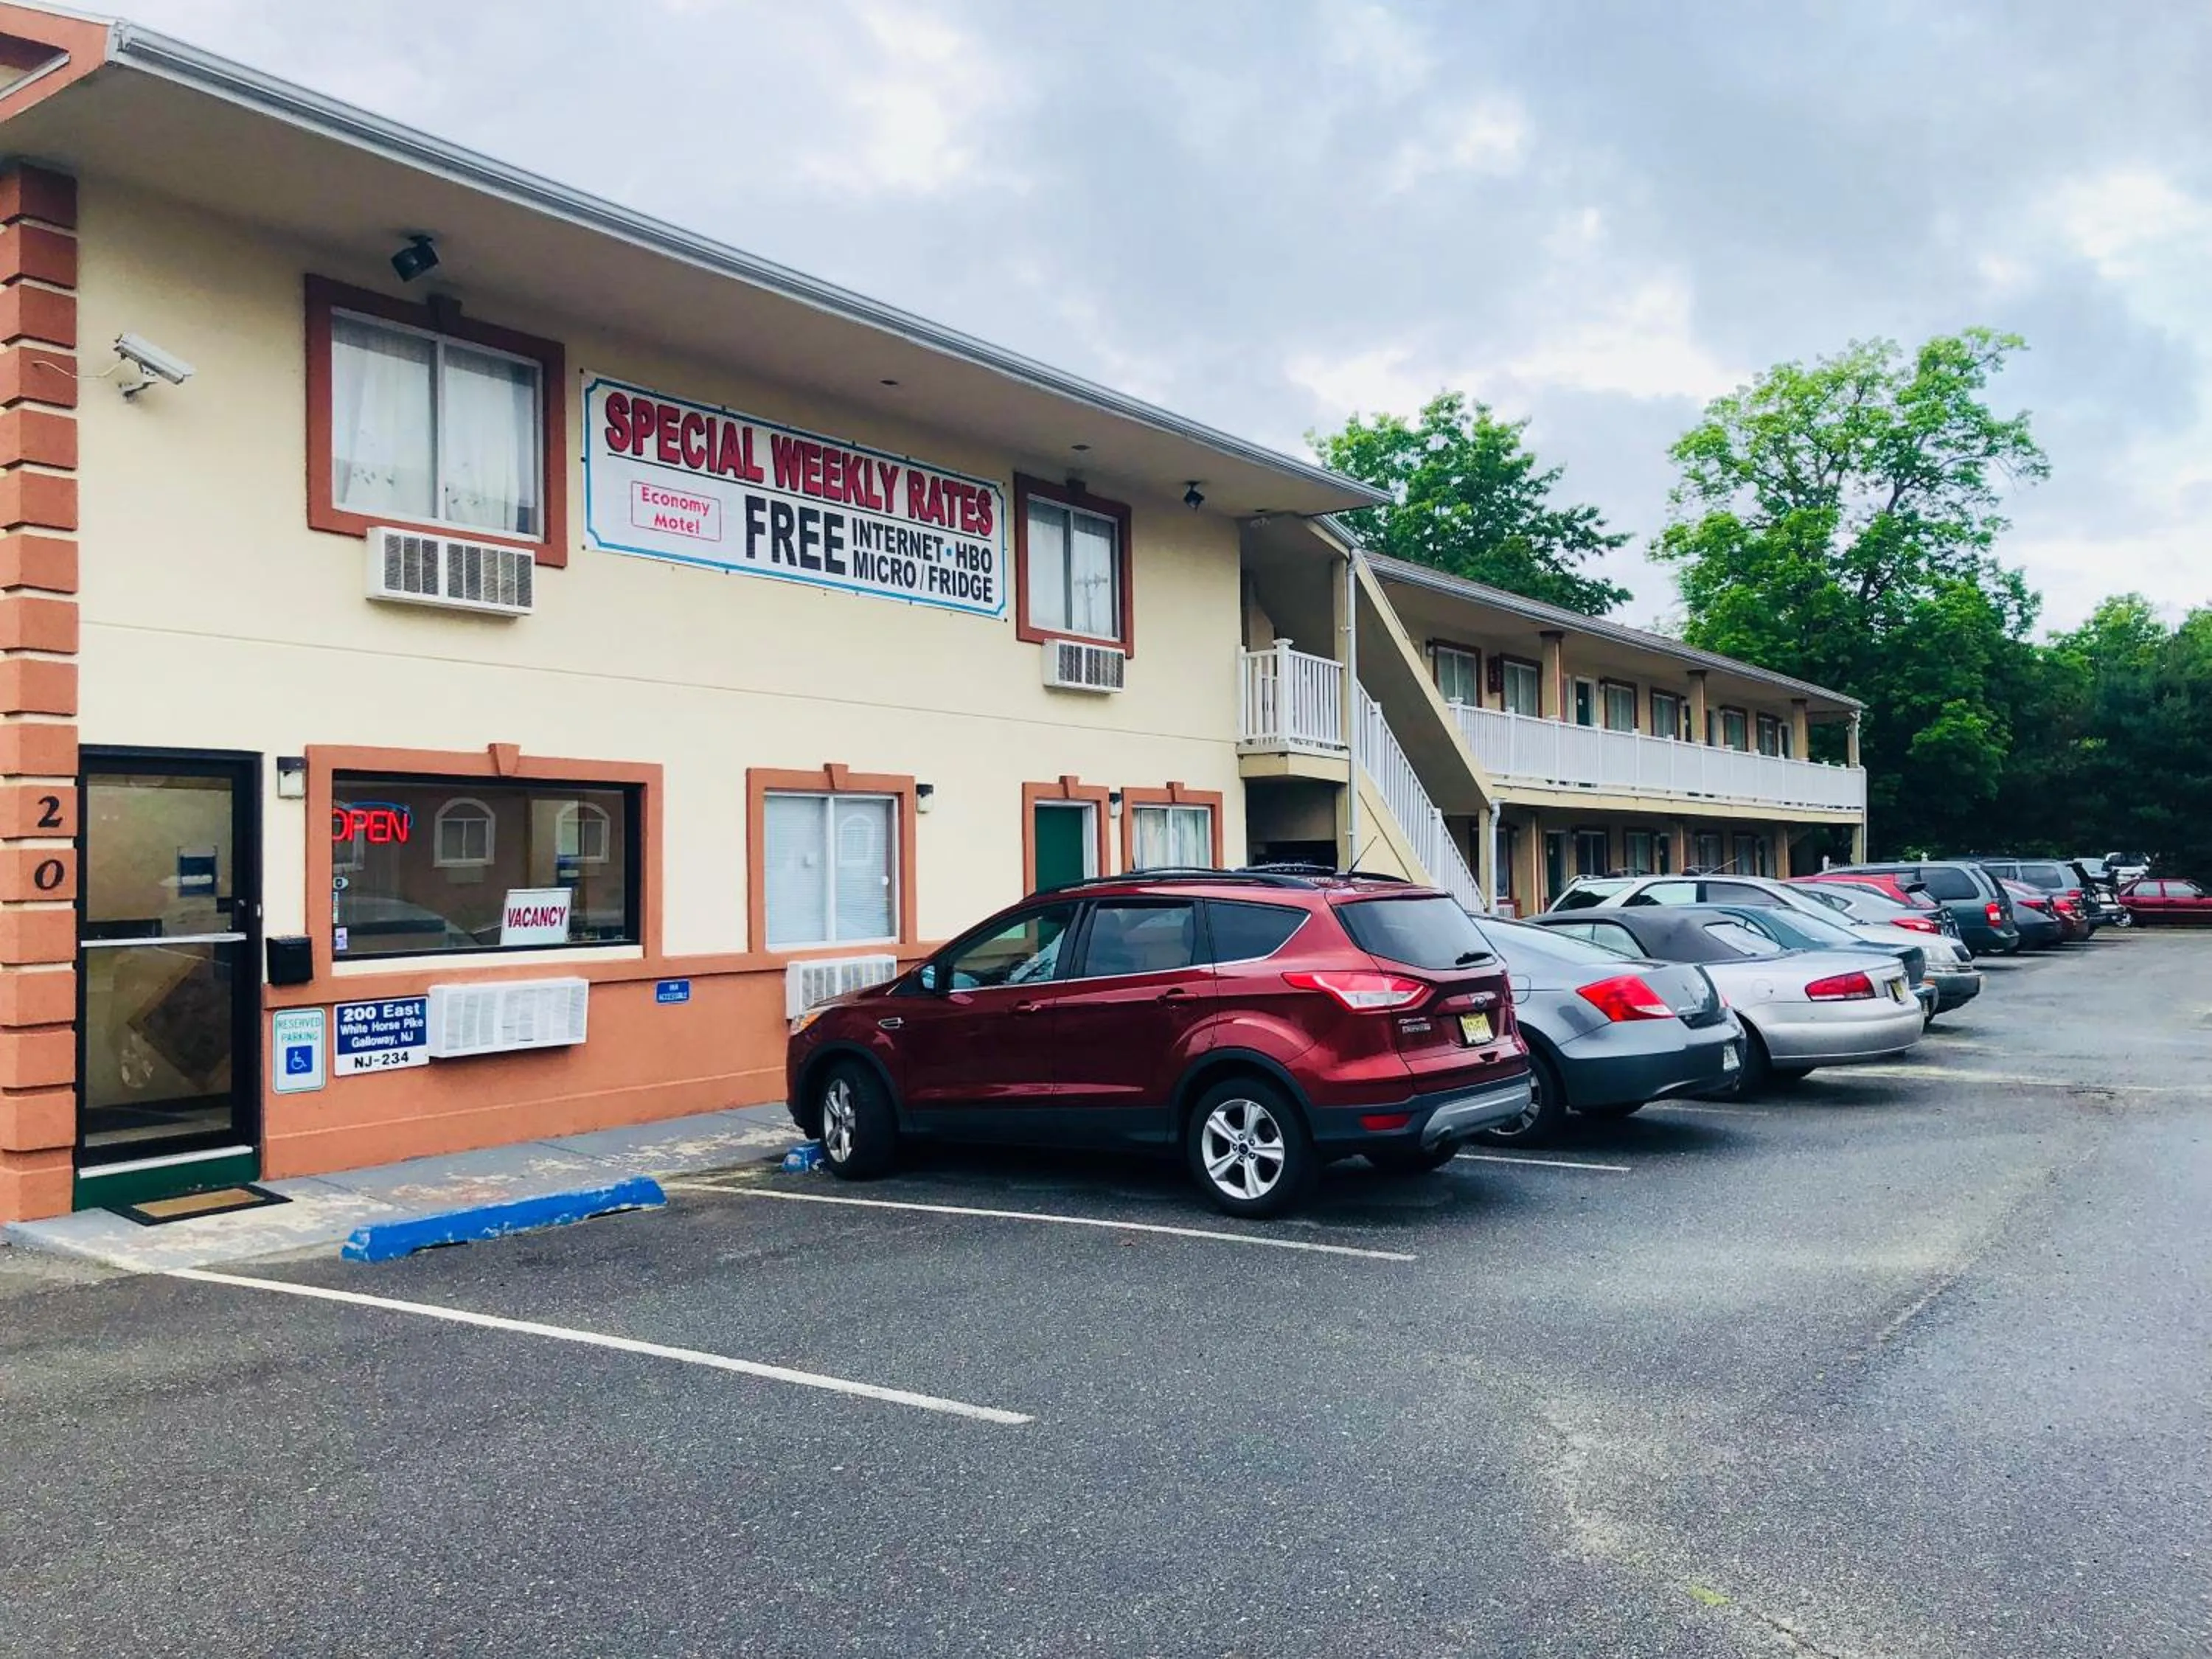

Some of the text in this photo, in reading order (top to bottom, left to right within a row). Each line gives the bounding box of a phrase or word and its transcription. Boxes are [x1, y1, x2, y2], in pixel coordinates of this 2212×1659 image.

[604, 391, 993, 538] SPECIAL WEEKLY RATES
[641, 485, 710, 516] Economy
[654, 513, 700, 534] Motel
[745, 494, 846, 575] FREE
[852, 518, 993, 574] INTERNET HBO
[853, 550, 917, 589] MICRO
[928, 566, 993, 603] FRIDGE
[38, 796, 63, 827] 2
[332, 808, 411, 844] OPEN
[507, 905, 567, 928] VACANCY
[340, 1017, 424, 1036] White Horse Pike
[343, 1002, 420, 1023] 200 East
[352, 1031, 414, 1048] Galloway, NJ
[355, 1051, 408, 1068] NJ-234
